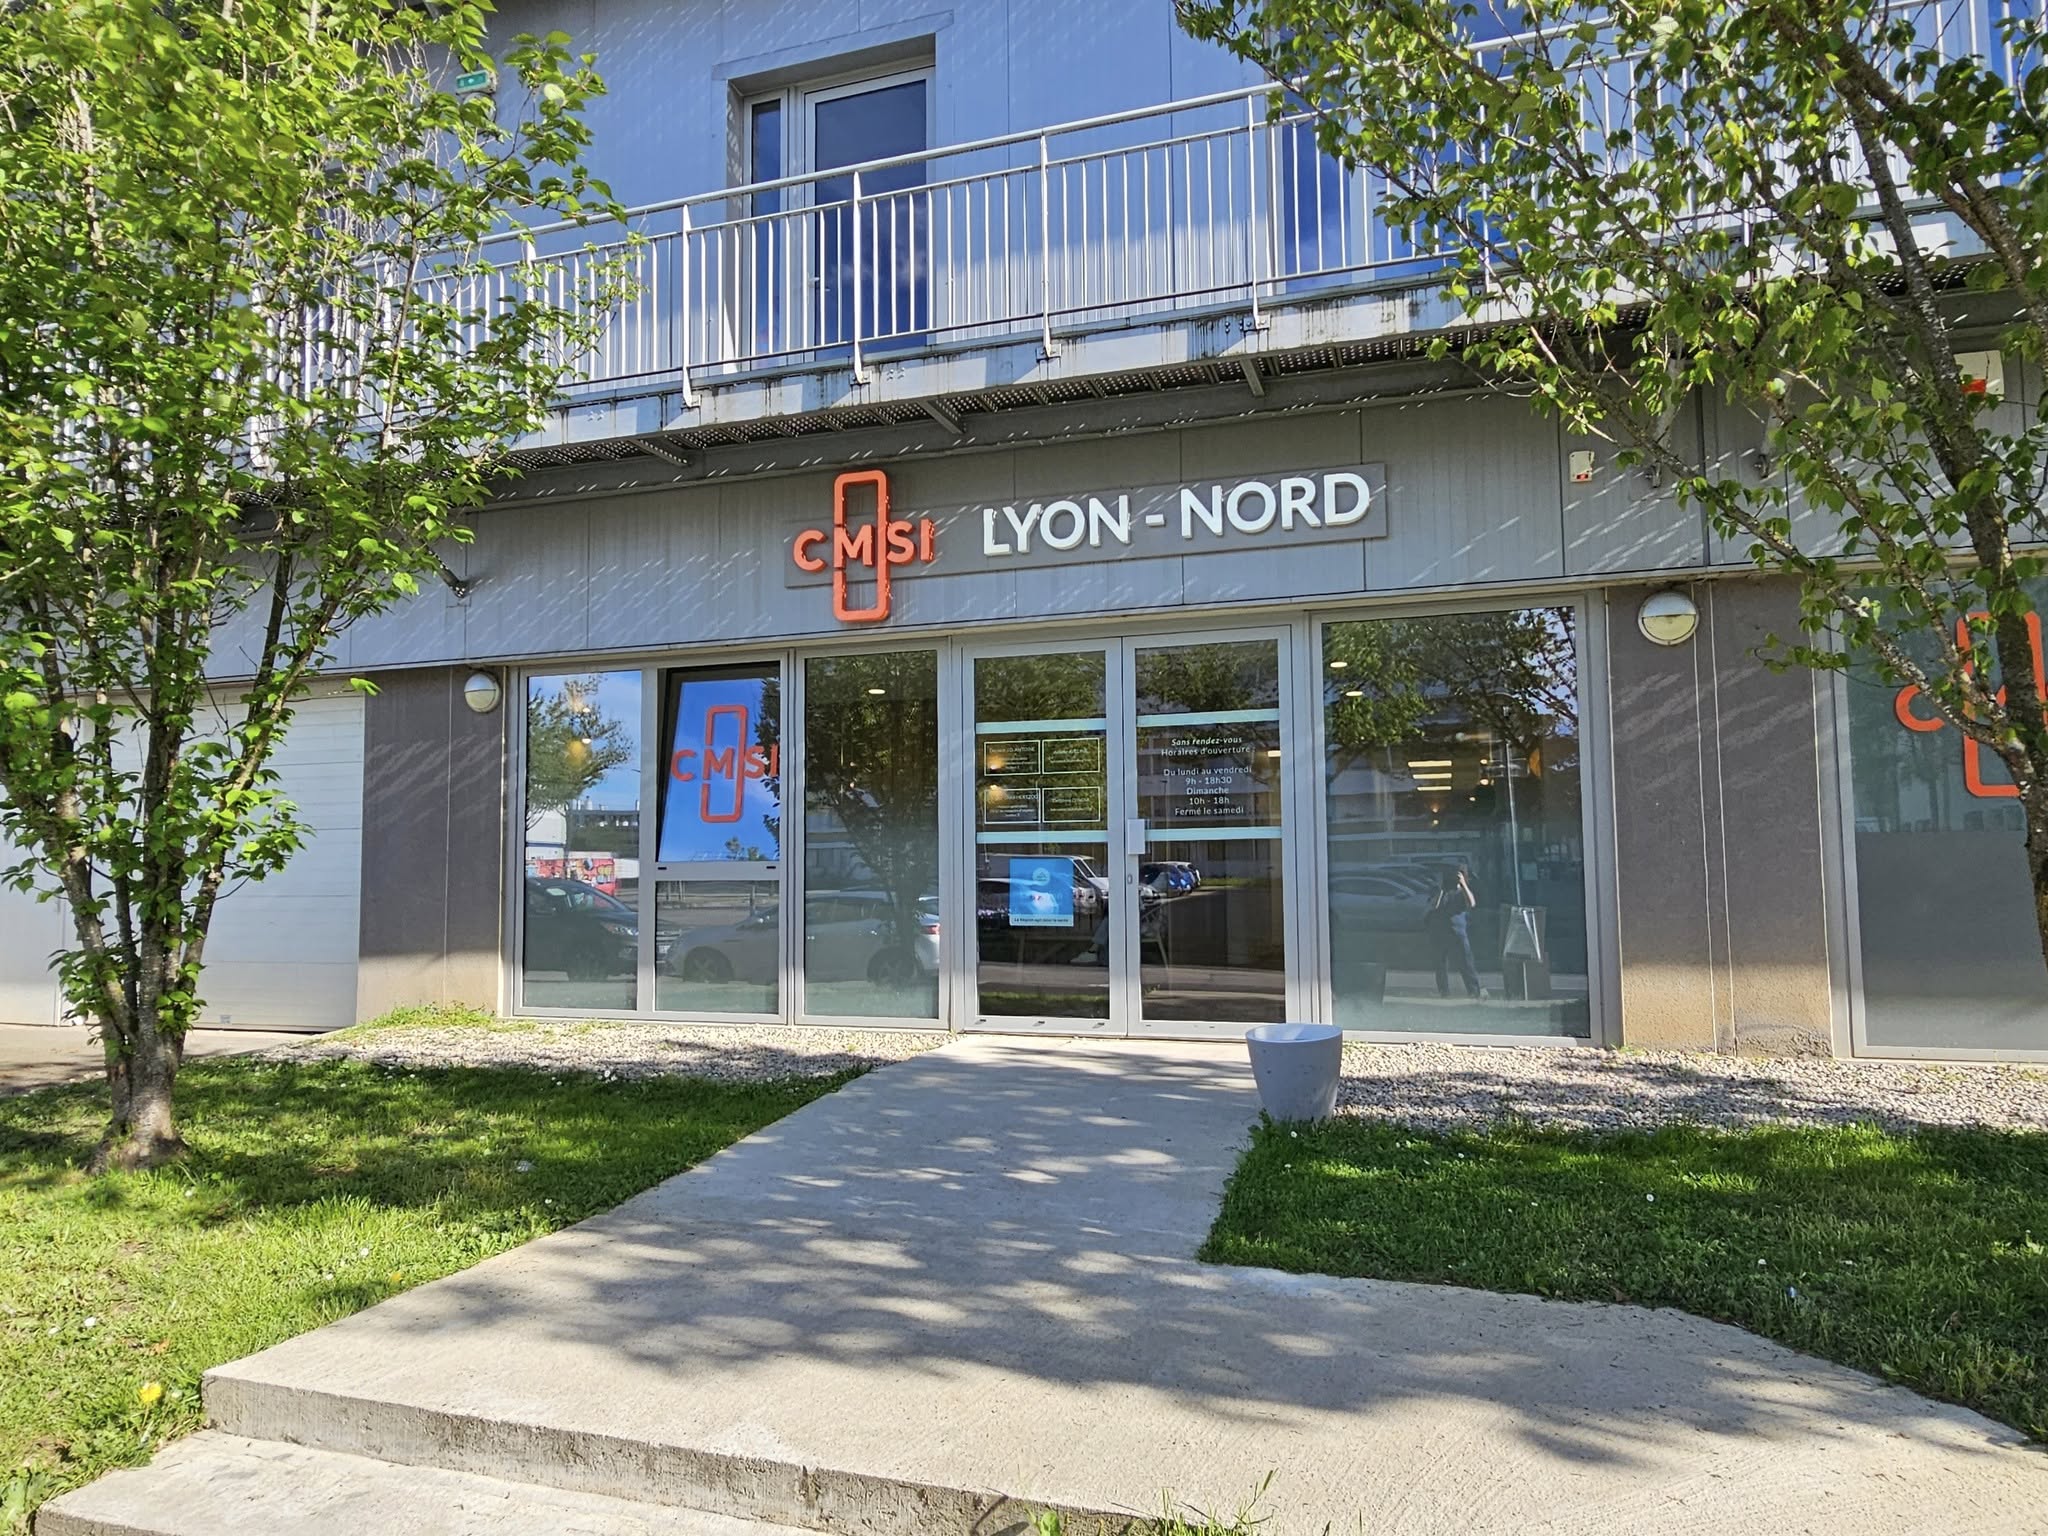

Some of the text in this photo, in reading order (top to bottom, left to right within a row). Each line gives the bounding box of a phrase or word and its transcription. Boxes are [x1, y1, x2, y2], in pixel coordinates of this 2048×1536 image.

[983, 494, 1131, 555] LYON
[1181, 472, 1370, 540] NORD
[793, 518, 934, 571] CMSI
[1171, 736, 1242, 746] Sans rendez-vous
[1161, 747, 1198, 757] Horaires
[1200, 746, 1250, 755] d'ouverture
[671, 743, 779, 782] CMSI
[1163, 768, 1176, 776] Du
[1177, 767, 1199, 776] lundi
[1213, 766, 1252, 775] vendredi
[1185, 777, 1197, 785] 9h
[1204, 776, 1233, 785] 18h30
[1186, 786, 1229, 795] Dimanche
[1189, 797, 1205, 805] 10h
[1214, 796, 1230, 805] 18h
[1175, 806, 1244, 816] Fermé le samedi
